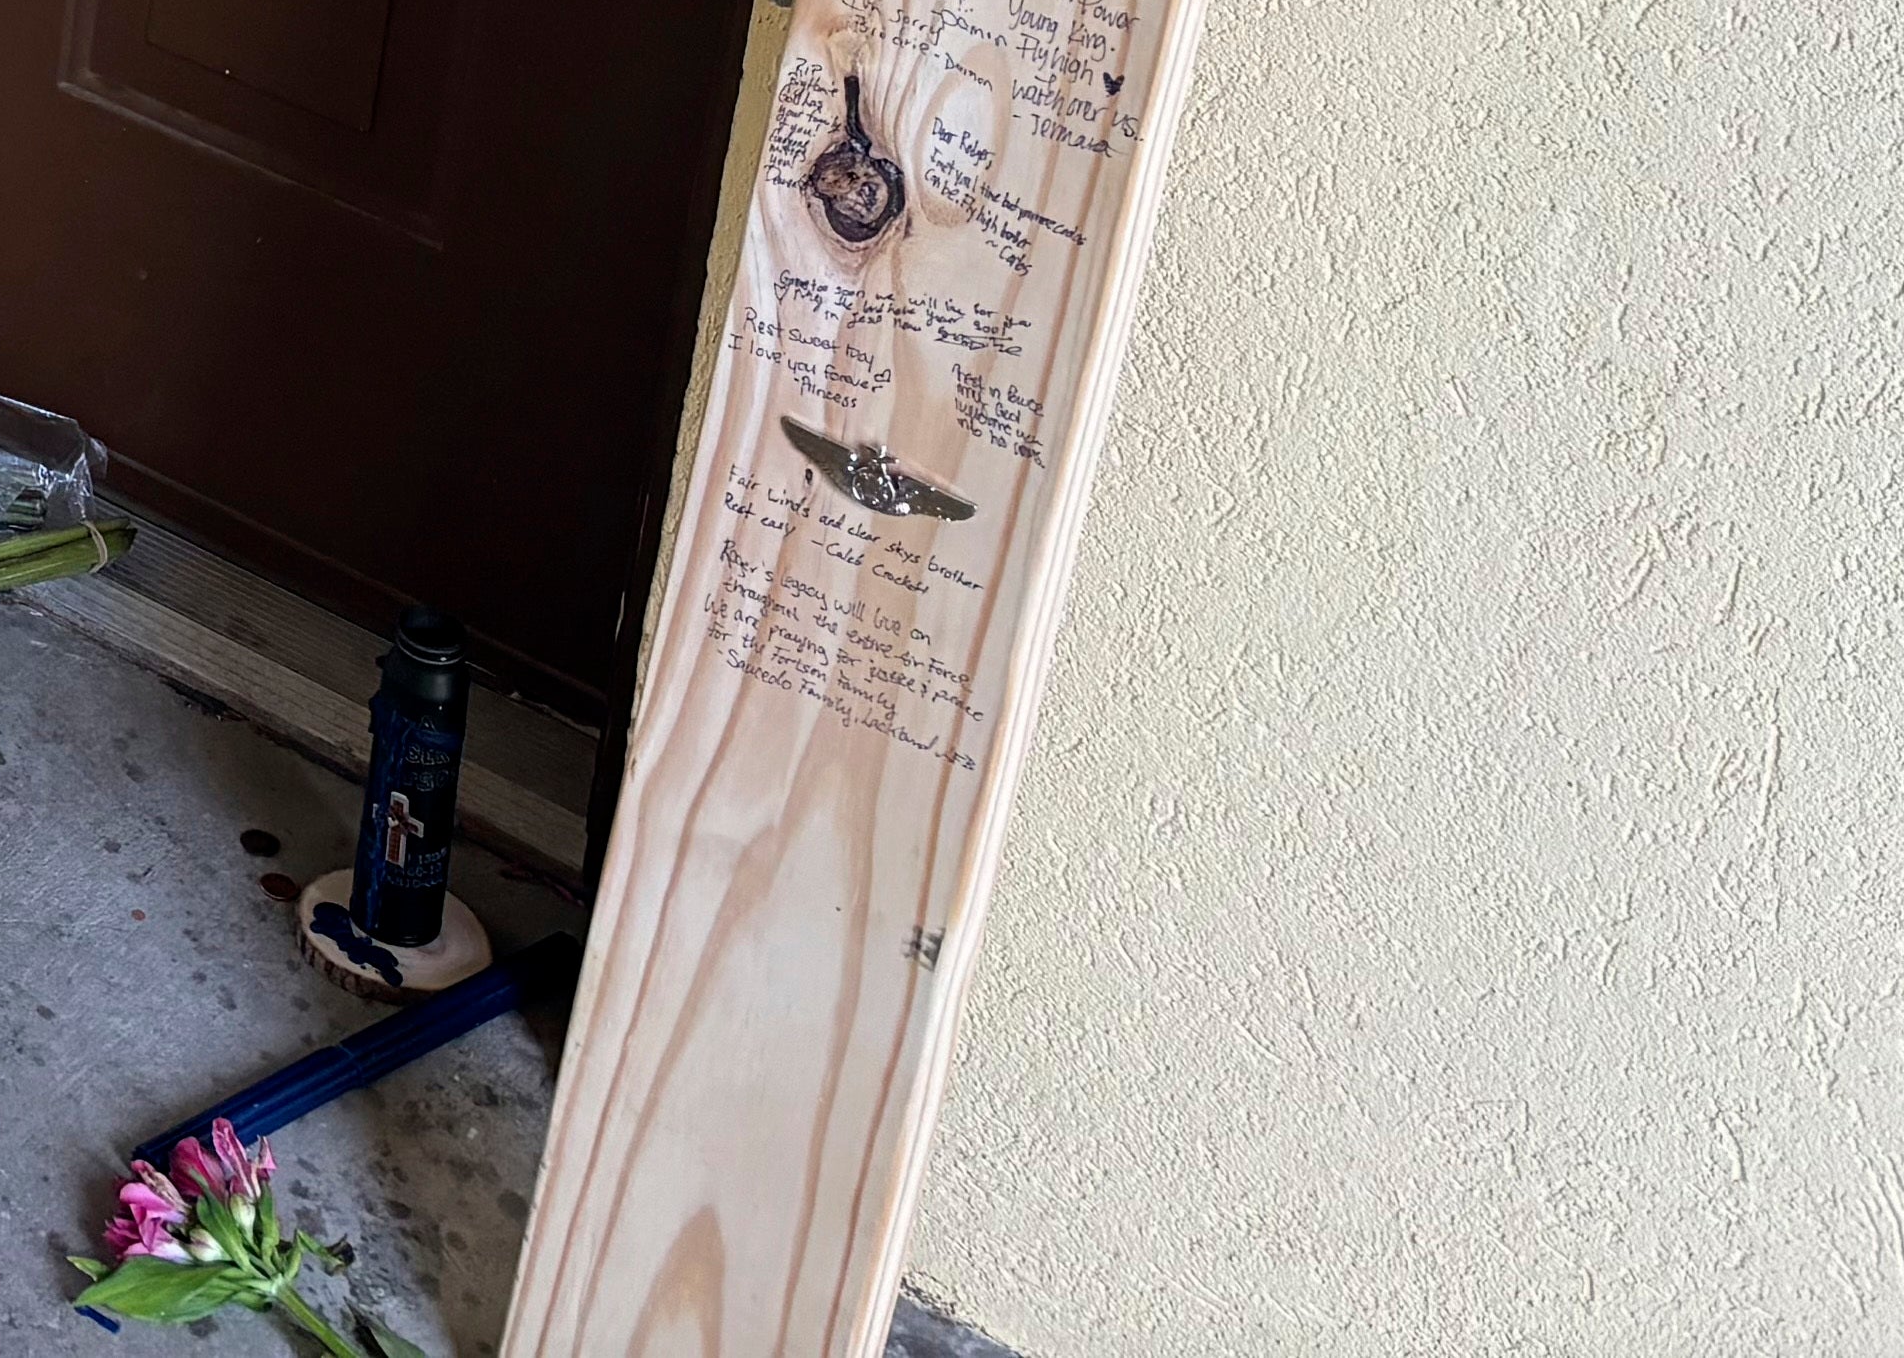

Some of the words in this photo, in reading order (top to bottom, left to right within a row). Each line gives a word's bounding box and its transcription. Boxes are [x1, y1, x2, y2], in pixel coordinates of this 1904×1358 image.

[743, 306, 785, 337] Rest
[727, 334, 744, 350] I
[728, 464, 760, 491] Fair
[704, 593, 728, 618] We
[834, 600, 866, 622] will
